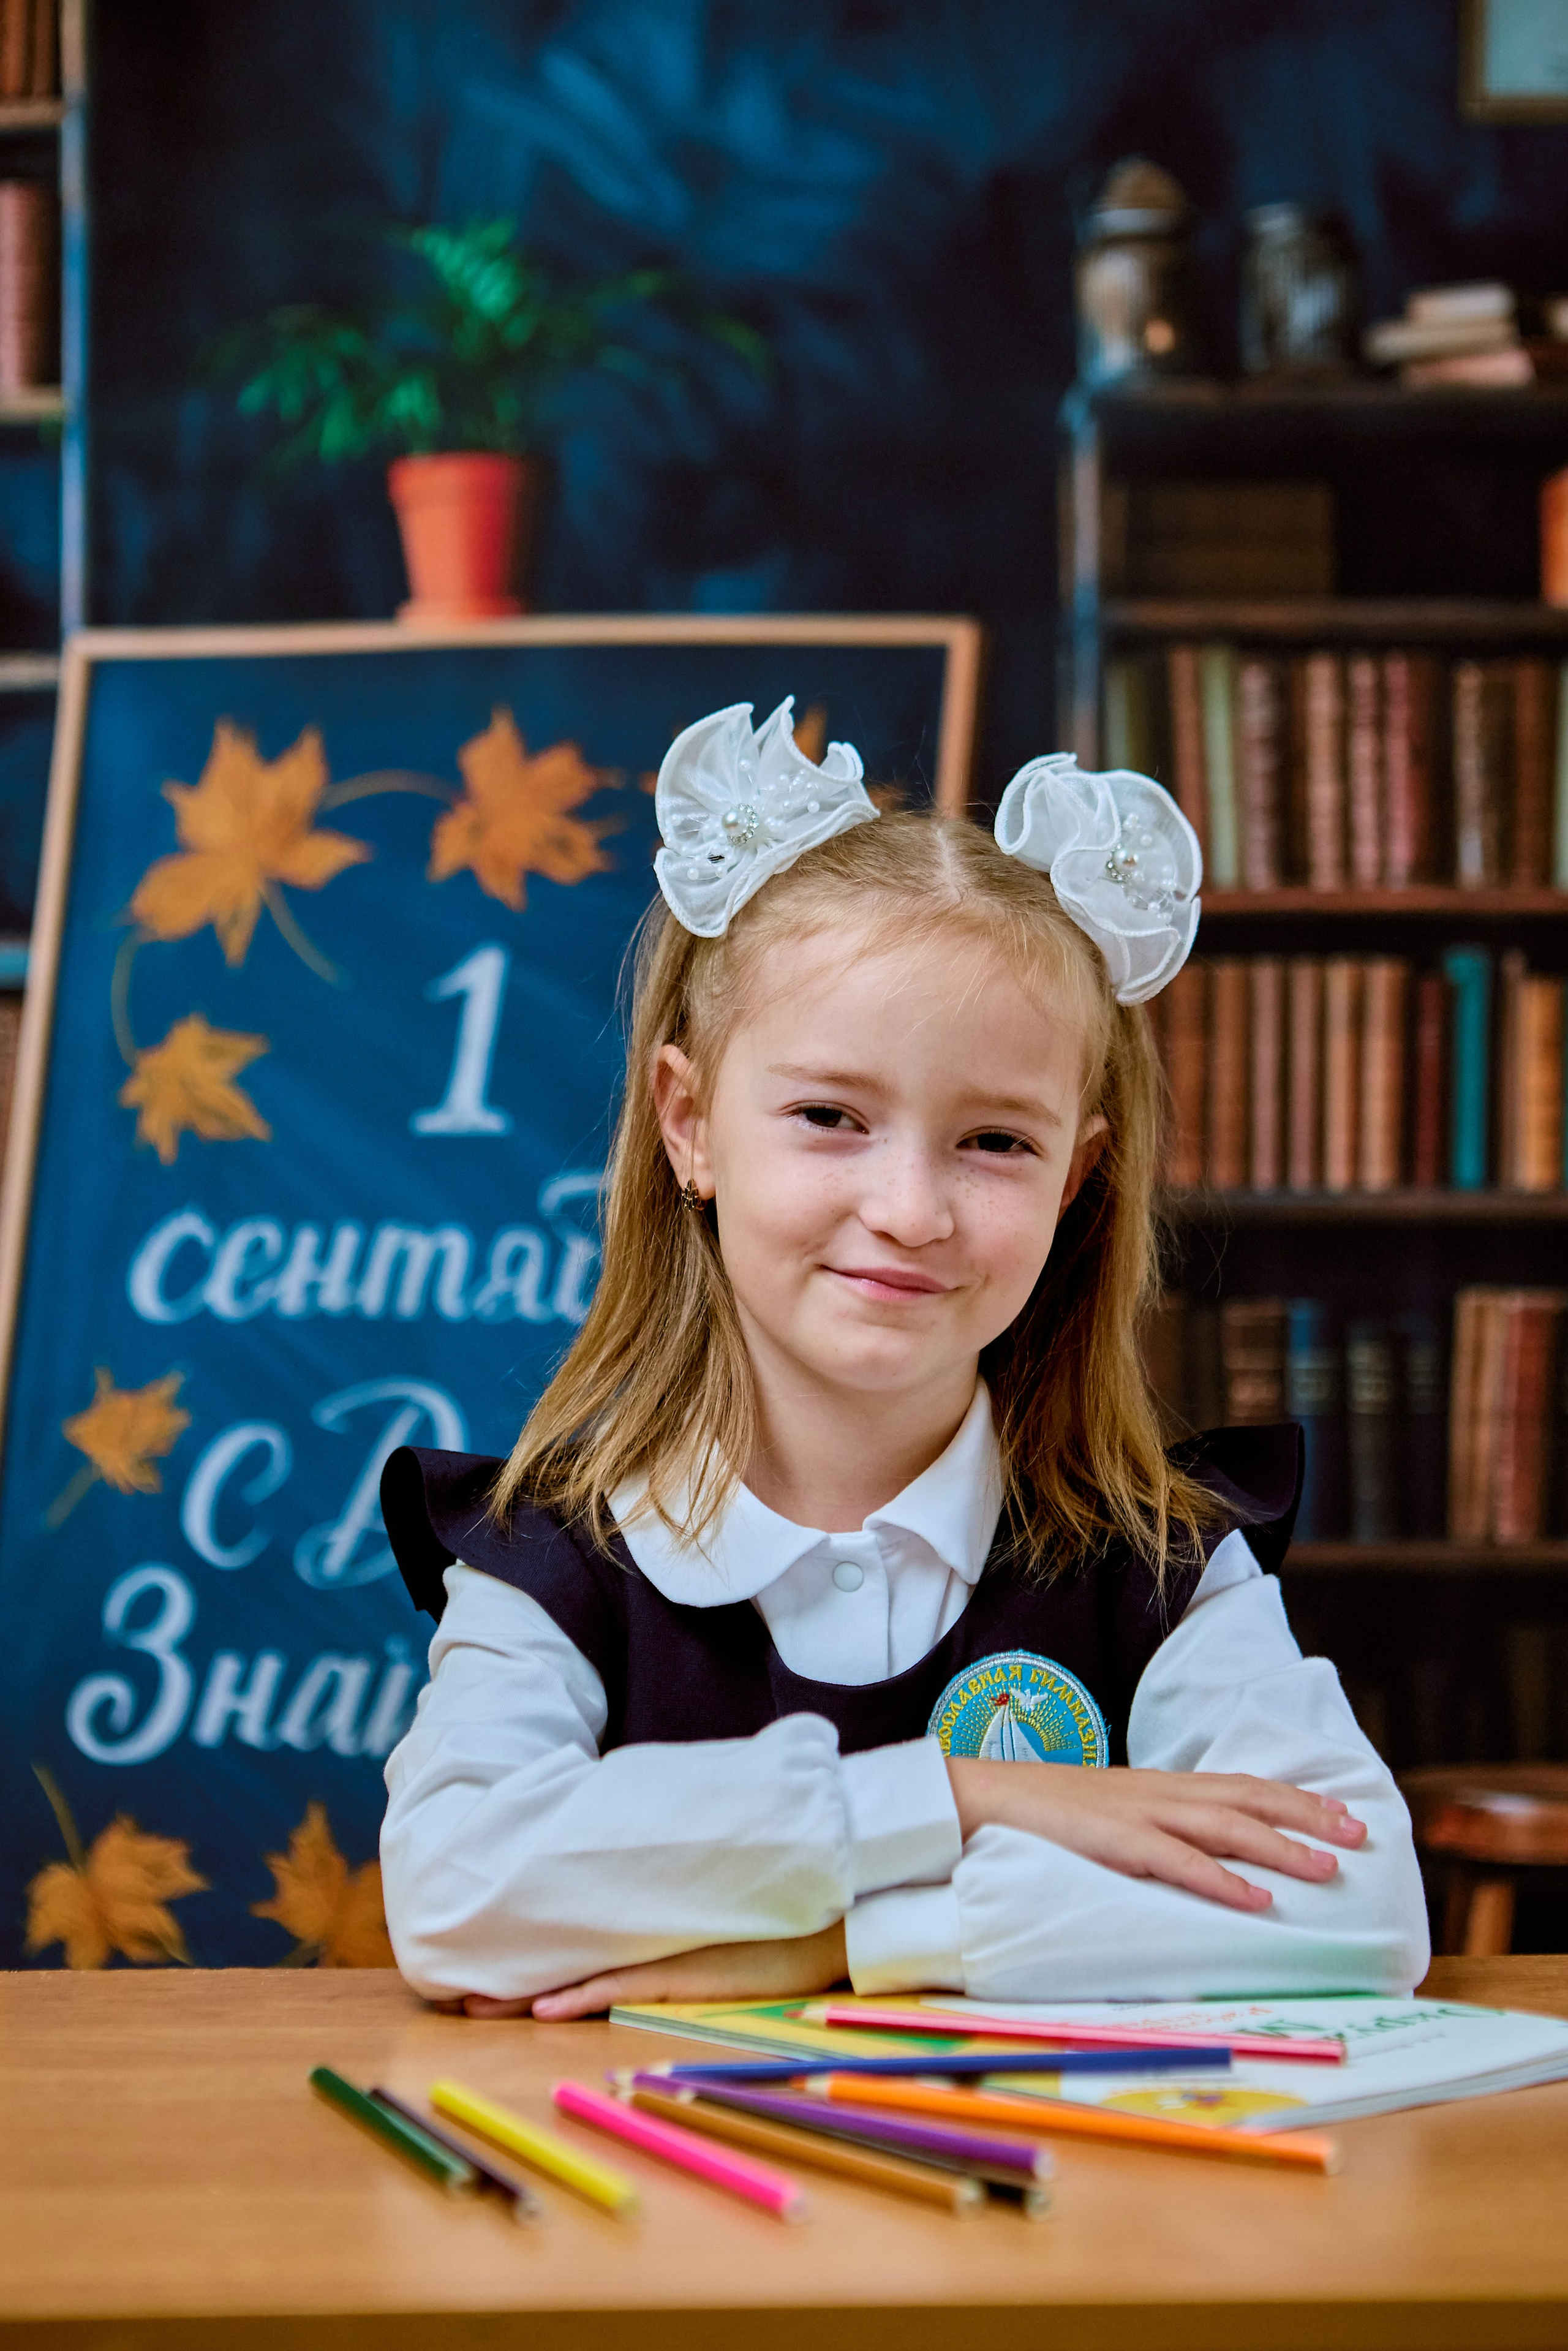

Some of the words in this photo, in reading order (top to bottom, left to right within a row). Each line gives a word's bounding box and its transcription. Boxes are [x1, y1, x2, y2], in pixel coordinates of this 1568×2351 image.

[409, 942, 514, 1137] 1
[66, 1562, 419, 1765] Зна
[938, 1665, 1022, 1757] ВОСЛАВНАЯ
